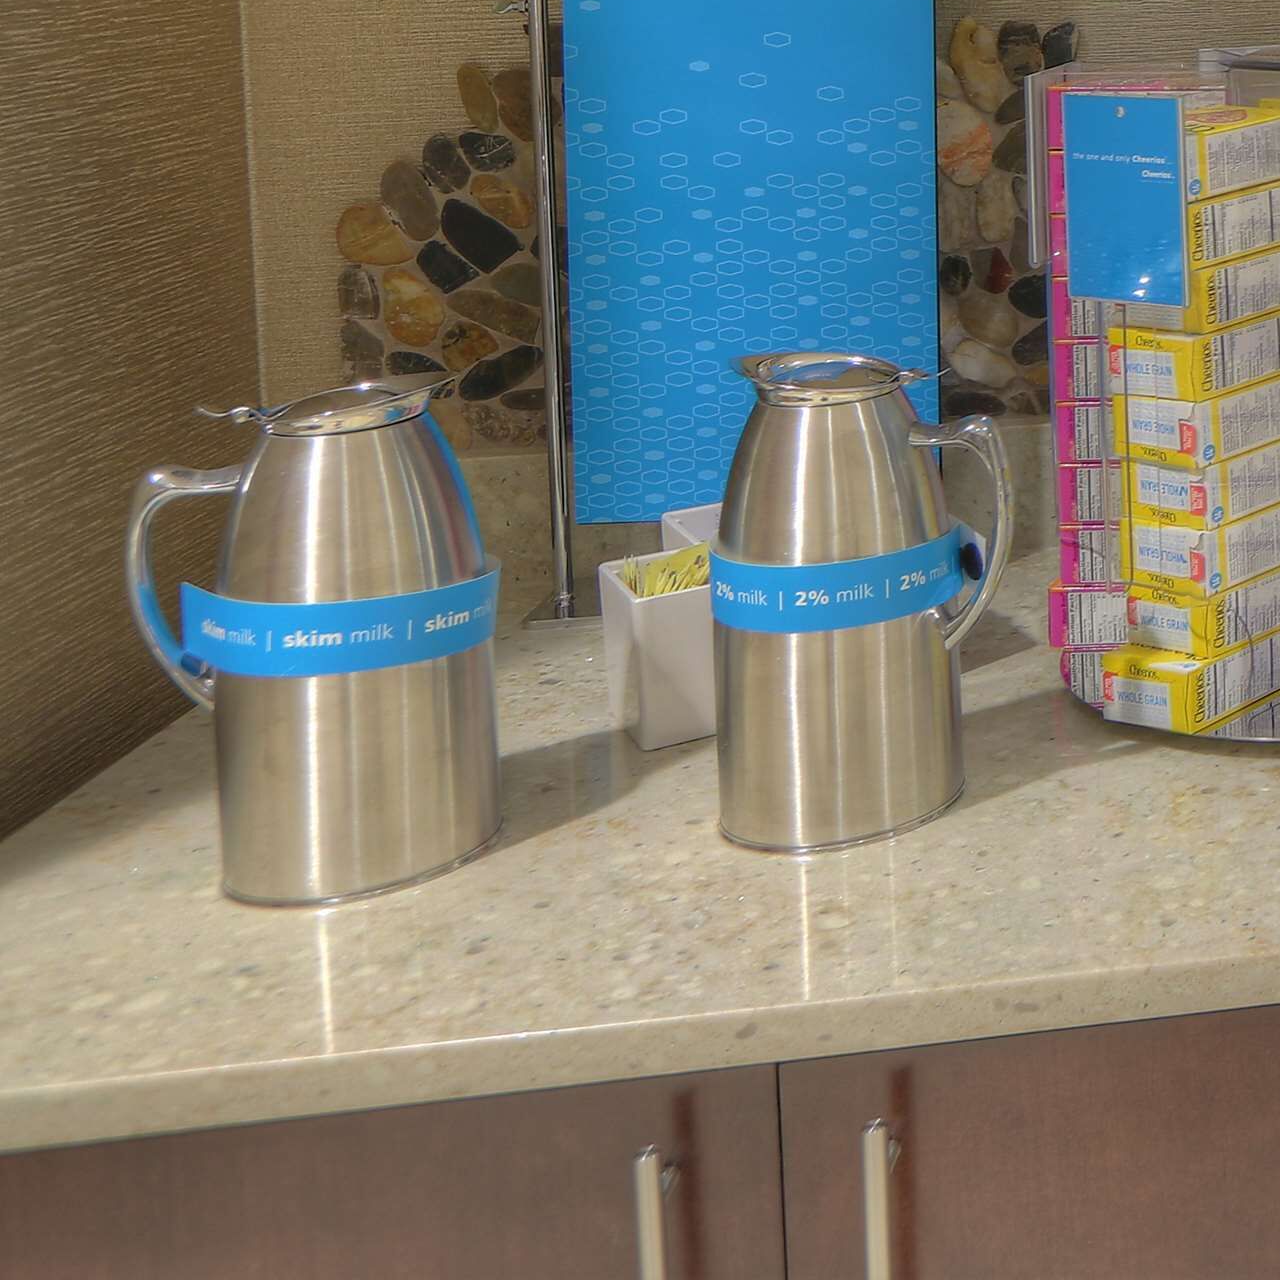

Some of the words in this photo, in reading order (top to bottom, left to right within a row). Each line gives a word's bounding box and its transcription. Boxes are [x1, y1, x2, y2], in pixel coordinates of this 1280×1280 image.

[716, 580, 735, 602] 2%
[737, 588, 768, 607] milk
[794, 588, 830, 608] 2%
[836, 583, 875, 603] milk
[899, 570, 926, 592] 2%
[201, 618, 227, 642] skim
[226, 626, 257, 647] milk
[282, 630, 344, 650] skim
[350, 623, 394, 645] milk
[423, 608, 471, 634] skim
[1140, 613, 1167, 629] WHOLE
[1167, 616, 1189, 632] GRAIN
[1212, 599, 1226, 650] Cheerios
[1117, 690, 1145, 706] WHOLE
[1144, 692, 1168, 708] GRAIN
[1194, 672, 1206, 724] Cheerios
